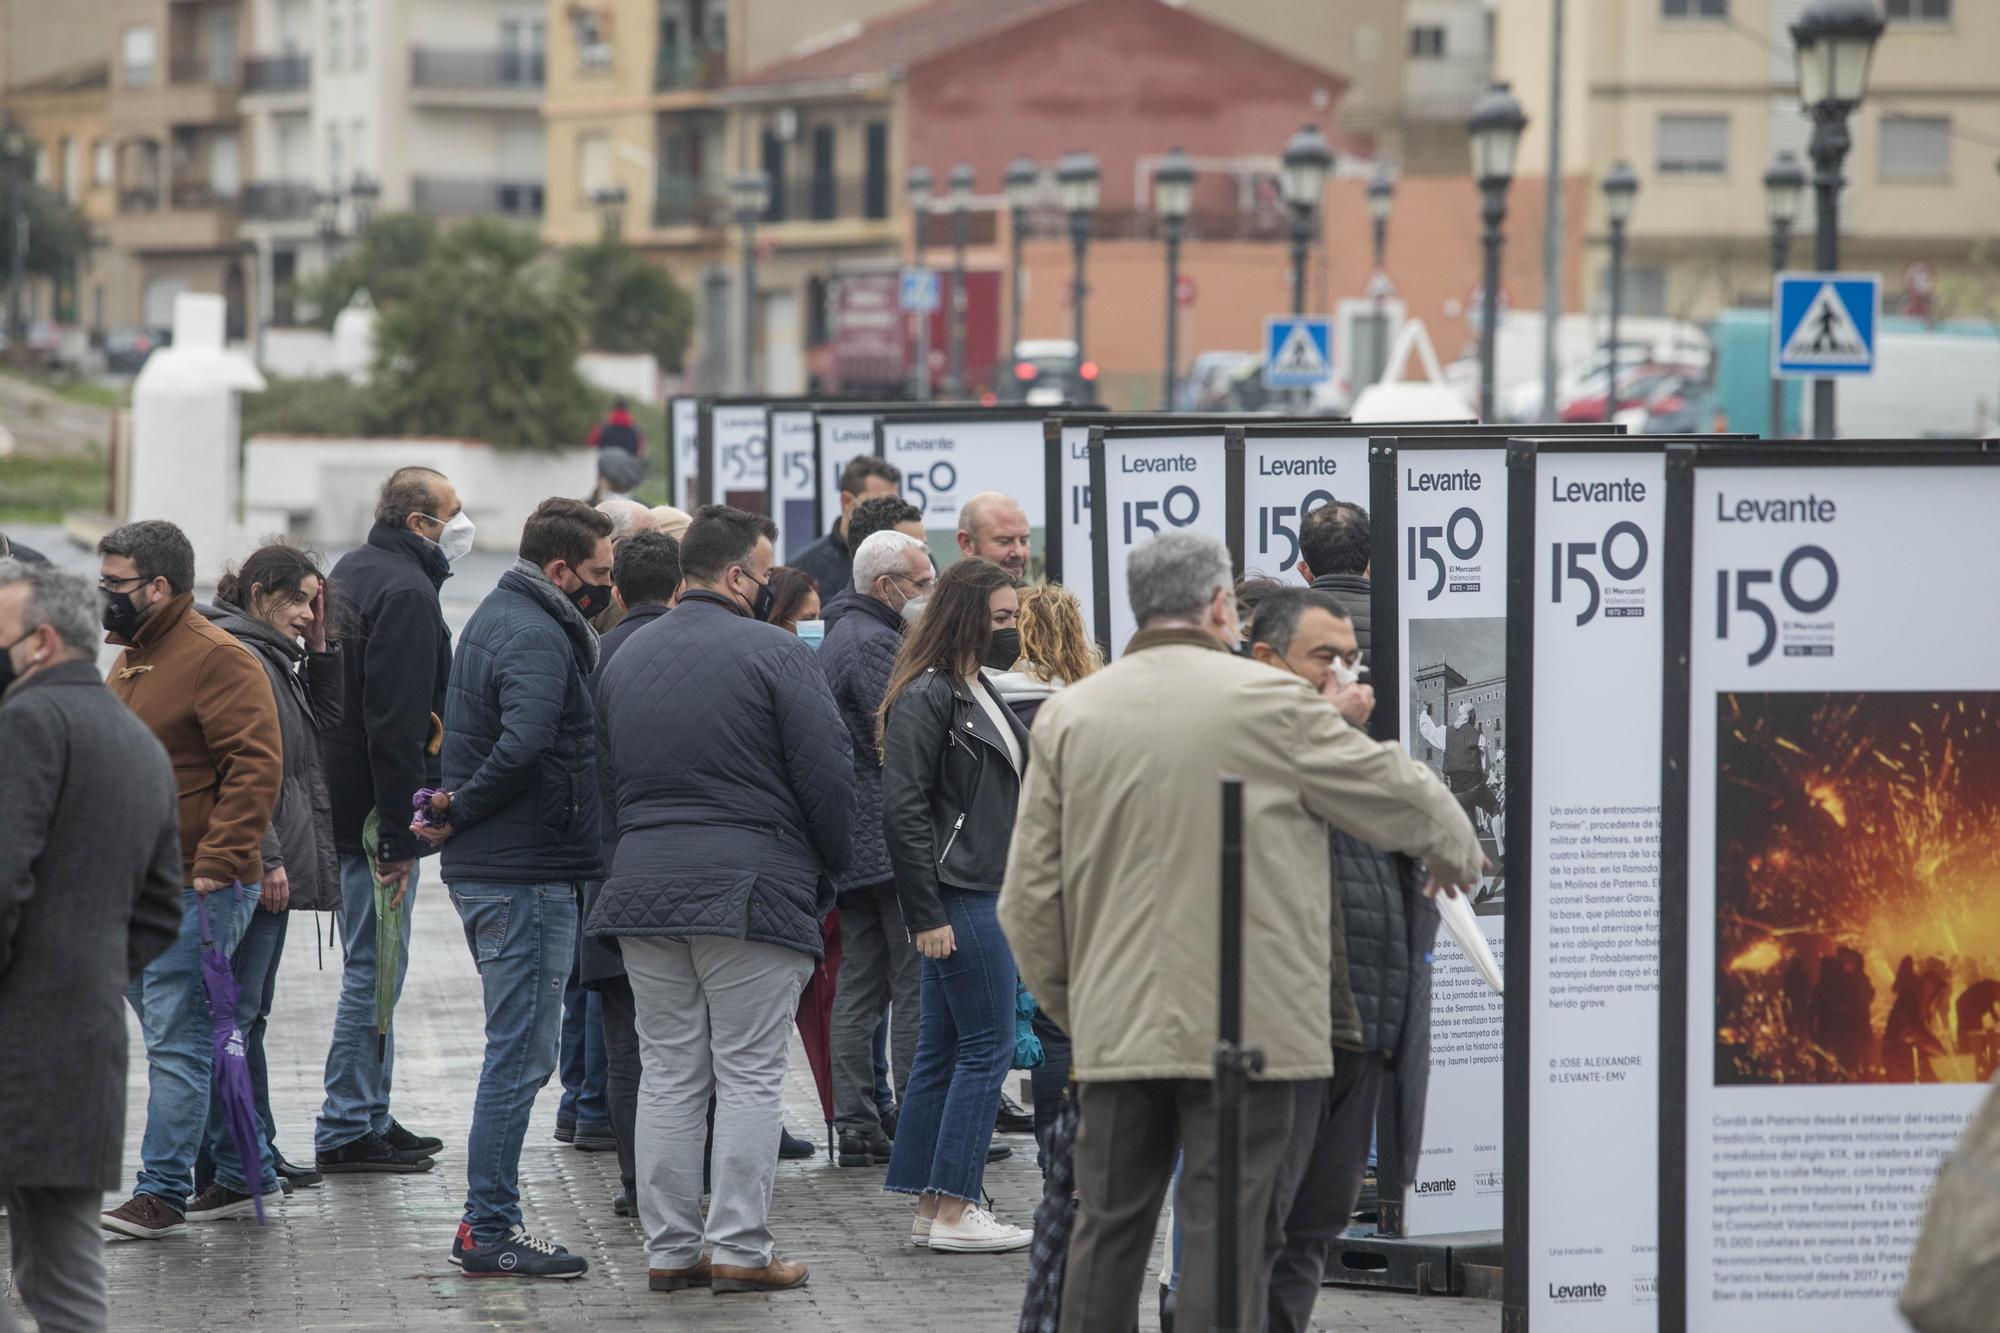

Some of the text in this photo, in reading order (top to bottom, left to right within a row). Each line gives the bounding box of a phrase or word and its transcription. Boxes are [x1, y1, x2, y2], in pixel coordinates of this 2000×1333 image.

[784, 451, 809, 488] 15
[1122, 455, 1197, 472] Levante
[1259, 455, 1336, 475] Levante
[898, 462, 955, 512] 50
[1407, 468, 1481, 491] Levante
[1552, 476, 1646, 502] Levante
[1717, 492, 1836, 523] Levante
[1407, 507, 1484, 601] 150
[1552, 520, 1649, 627] 150
[1716, 544, 1839, 668] 150
[1603, 804, 1661, 814] entrenamient
[1645, 834, 1659, 843] est
[1645, 923, 1657, 932] for
[1432, 951, 1465, 963] gularidad.
[1431, 977, 1453, 987] ividad
[1471, 976, 1485, 987] algu
[1432, 1018, 1451, 1027] dades
[1489, 1015, 1503, 1024] tant
[1432, 1043, 1455, 1053] cación
[1560, 1058, 1581, 1068] JOSE
[1584, 1057, 1642, 1067] ALEIXANDRE
[1414, 1178, 1456, 1193] Levante
[1549, 1282, 1606, 1298] Levante
